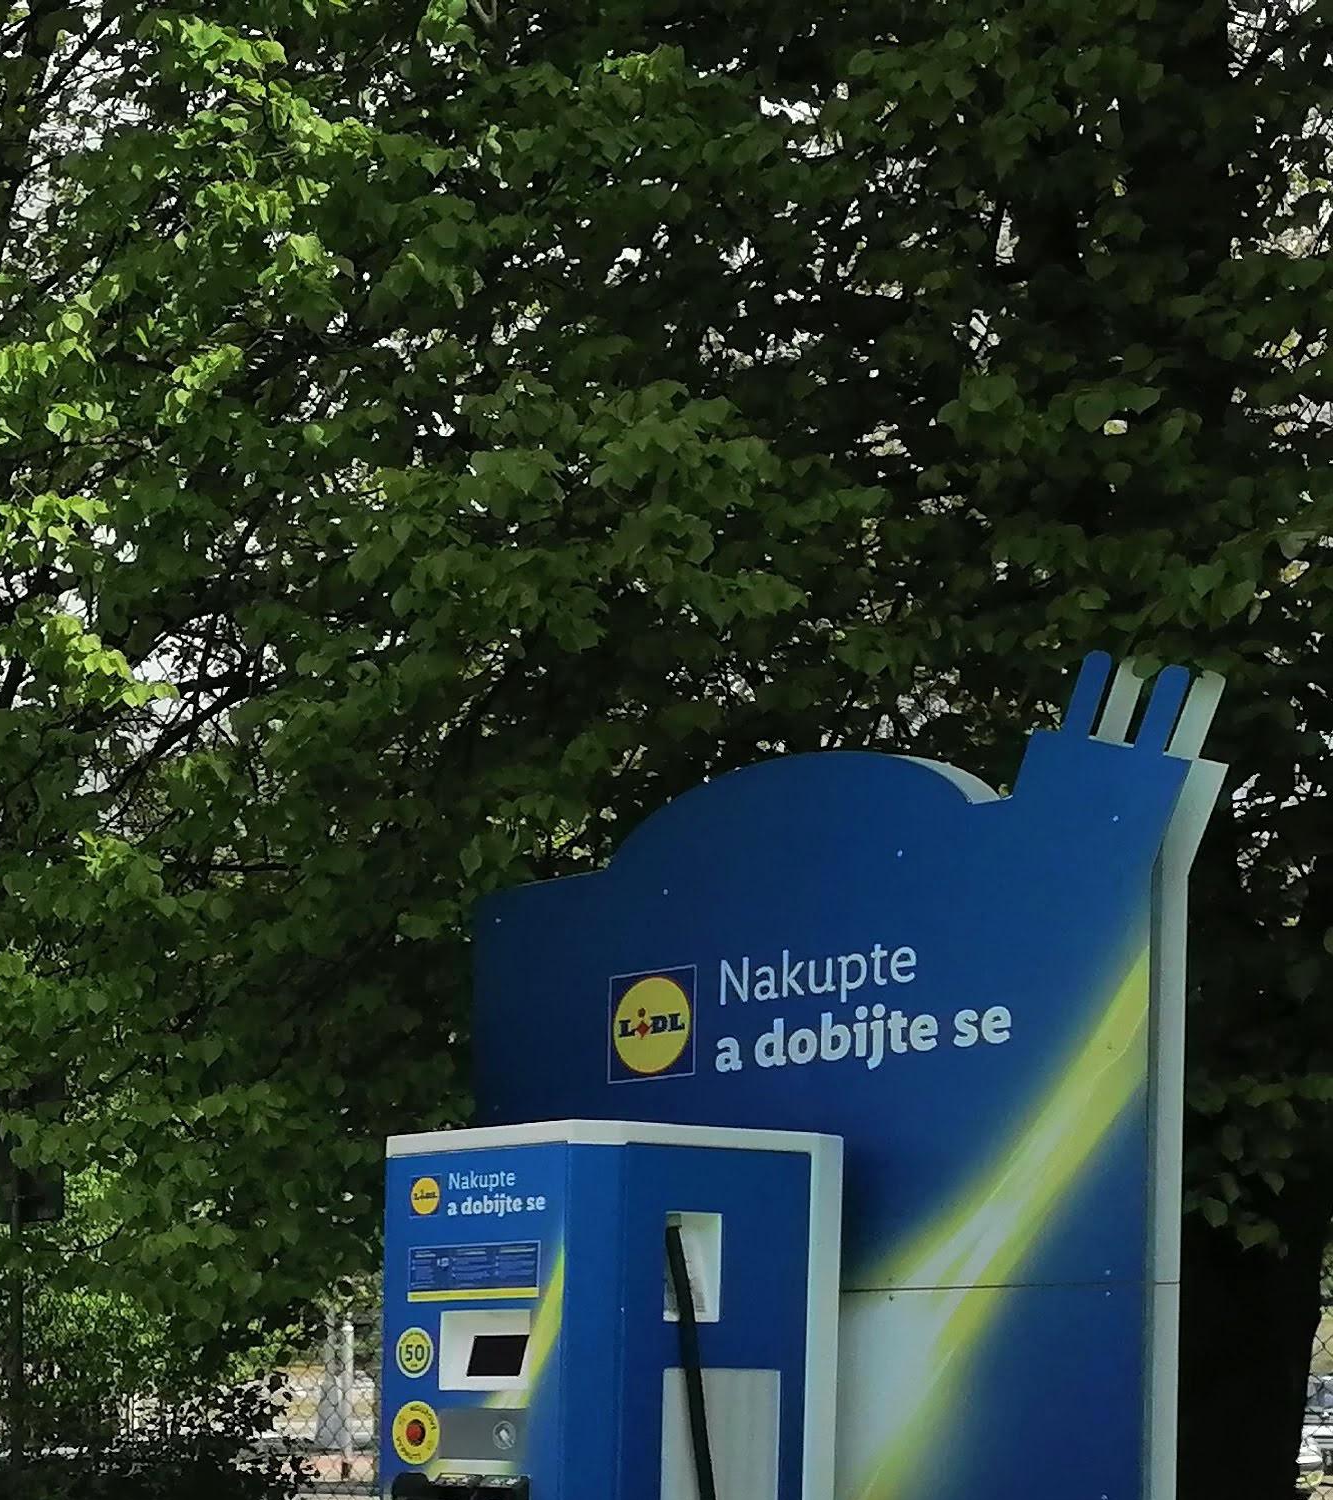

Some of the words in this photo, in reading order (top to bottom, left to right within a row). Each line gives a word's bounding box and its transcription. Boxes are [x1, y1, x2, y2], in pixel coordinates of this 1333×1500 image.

[719, 943, 918, 1006] Nakupte
[715, 1036, 743, 1073] a
[754, 1003, 939, 1070] dobijte
[953, 1005, 1012, 1048] se
[448, 1170, 516, 1192] Nakupte
[447, 1201, 458, 1216] a
[461, 1193, 522, 1217] dobijte
[526, 1195, 546, 1212] se
[405, 1344, 425, 1362] 50
